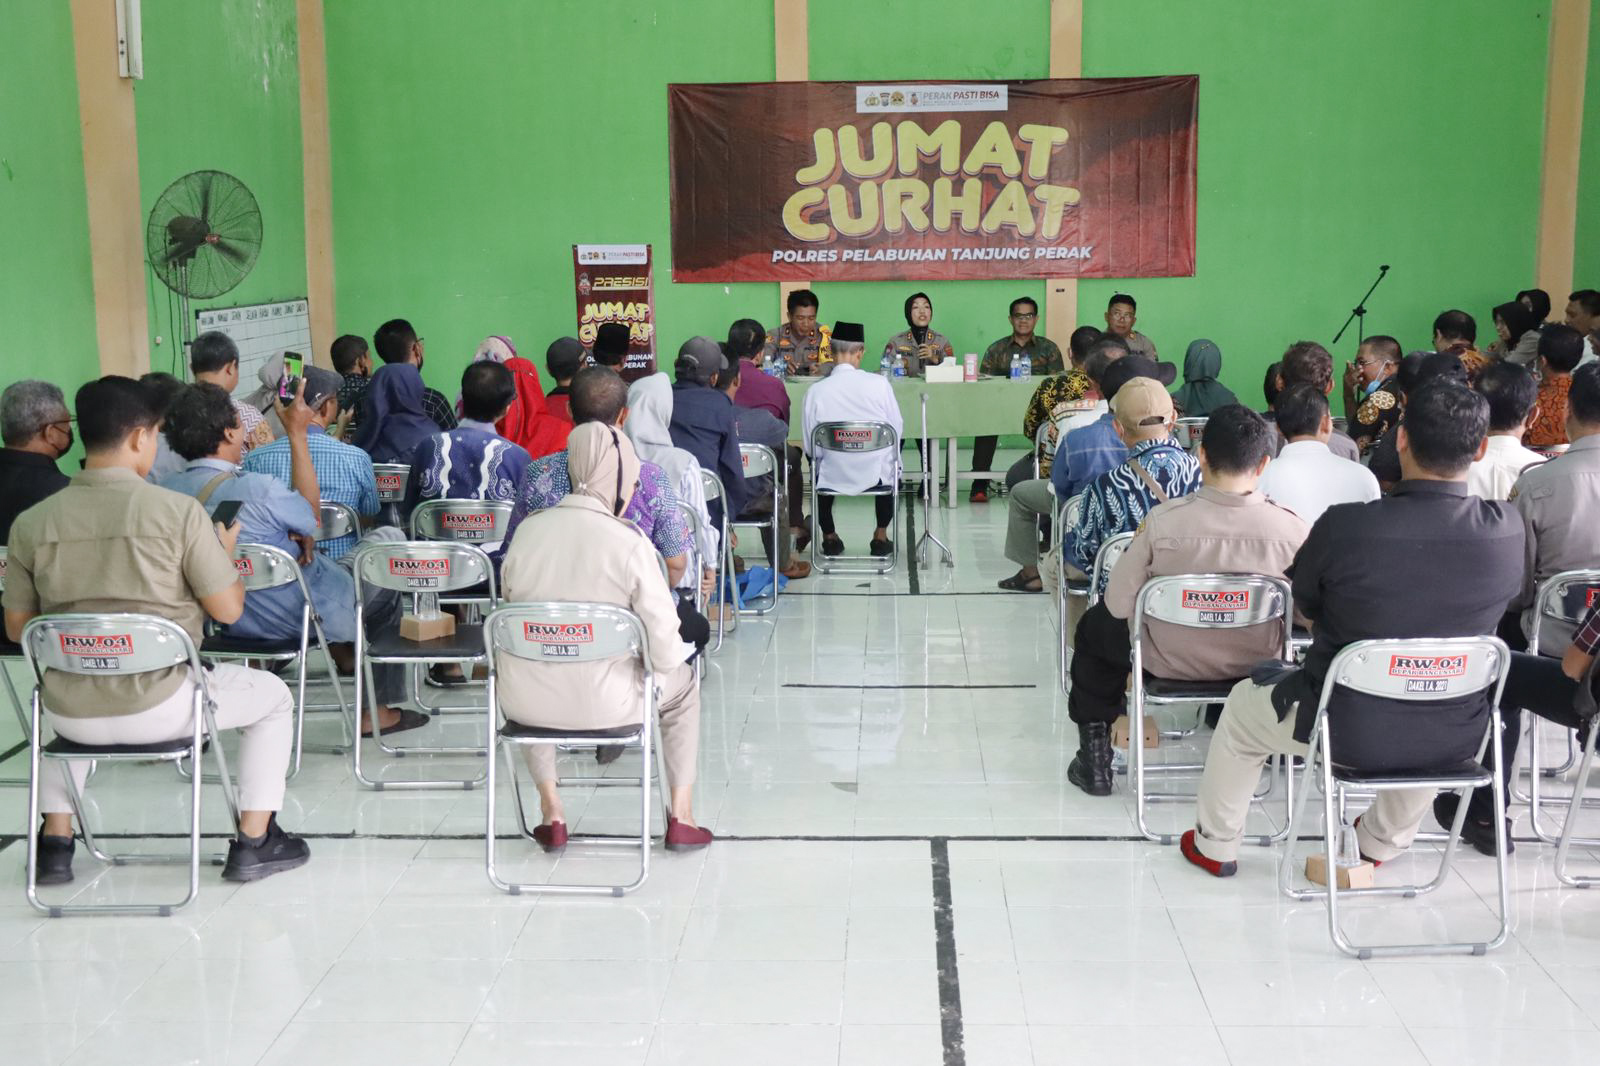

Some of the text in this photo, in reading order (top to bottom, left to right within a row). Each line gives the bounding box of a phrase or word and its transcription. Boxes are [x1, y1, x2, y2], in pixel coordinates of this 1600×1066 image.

[922, 90, 1000, 100] PERAK PASTI BISA
[795, 119, 1069, 186] JUMAT
[782, 177, 1081, 242] CURHAT
[772, 246, 1093, 263] POLRES PELABUHAN TANJUNG PERAK
[593, 276, 648, 287] PRESISI
[581, 301, 649, 324] JUMAT
[579, 321, 653, 343] CUAT
[623, 361, 647, 369] PERAK
[394, 560, 445, 570] RW.04
[1187, 592, 1245, 602] RW.04
[1200, 612, 1214, 622] DAKEL
[1224, 612, 1234, 622] 2021
[528, 625, 588, 635] RW.04
[63, 636, 127, 647] RW.04
[543, 644, 557, 655] DAKEL
[567, 645, 578, 656] 2021
[82, 657, 97, 668] DAKEL
[107, 657, 118, 668] 2021
[1396, 658, 1462, 669] RW.04
[1408, 680, 1424, 691] DAKEL
[1435, 680, 1447, 691] 2021
